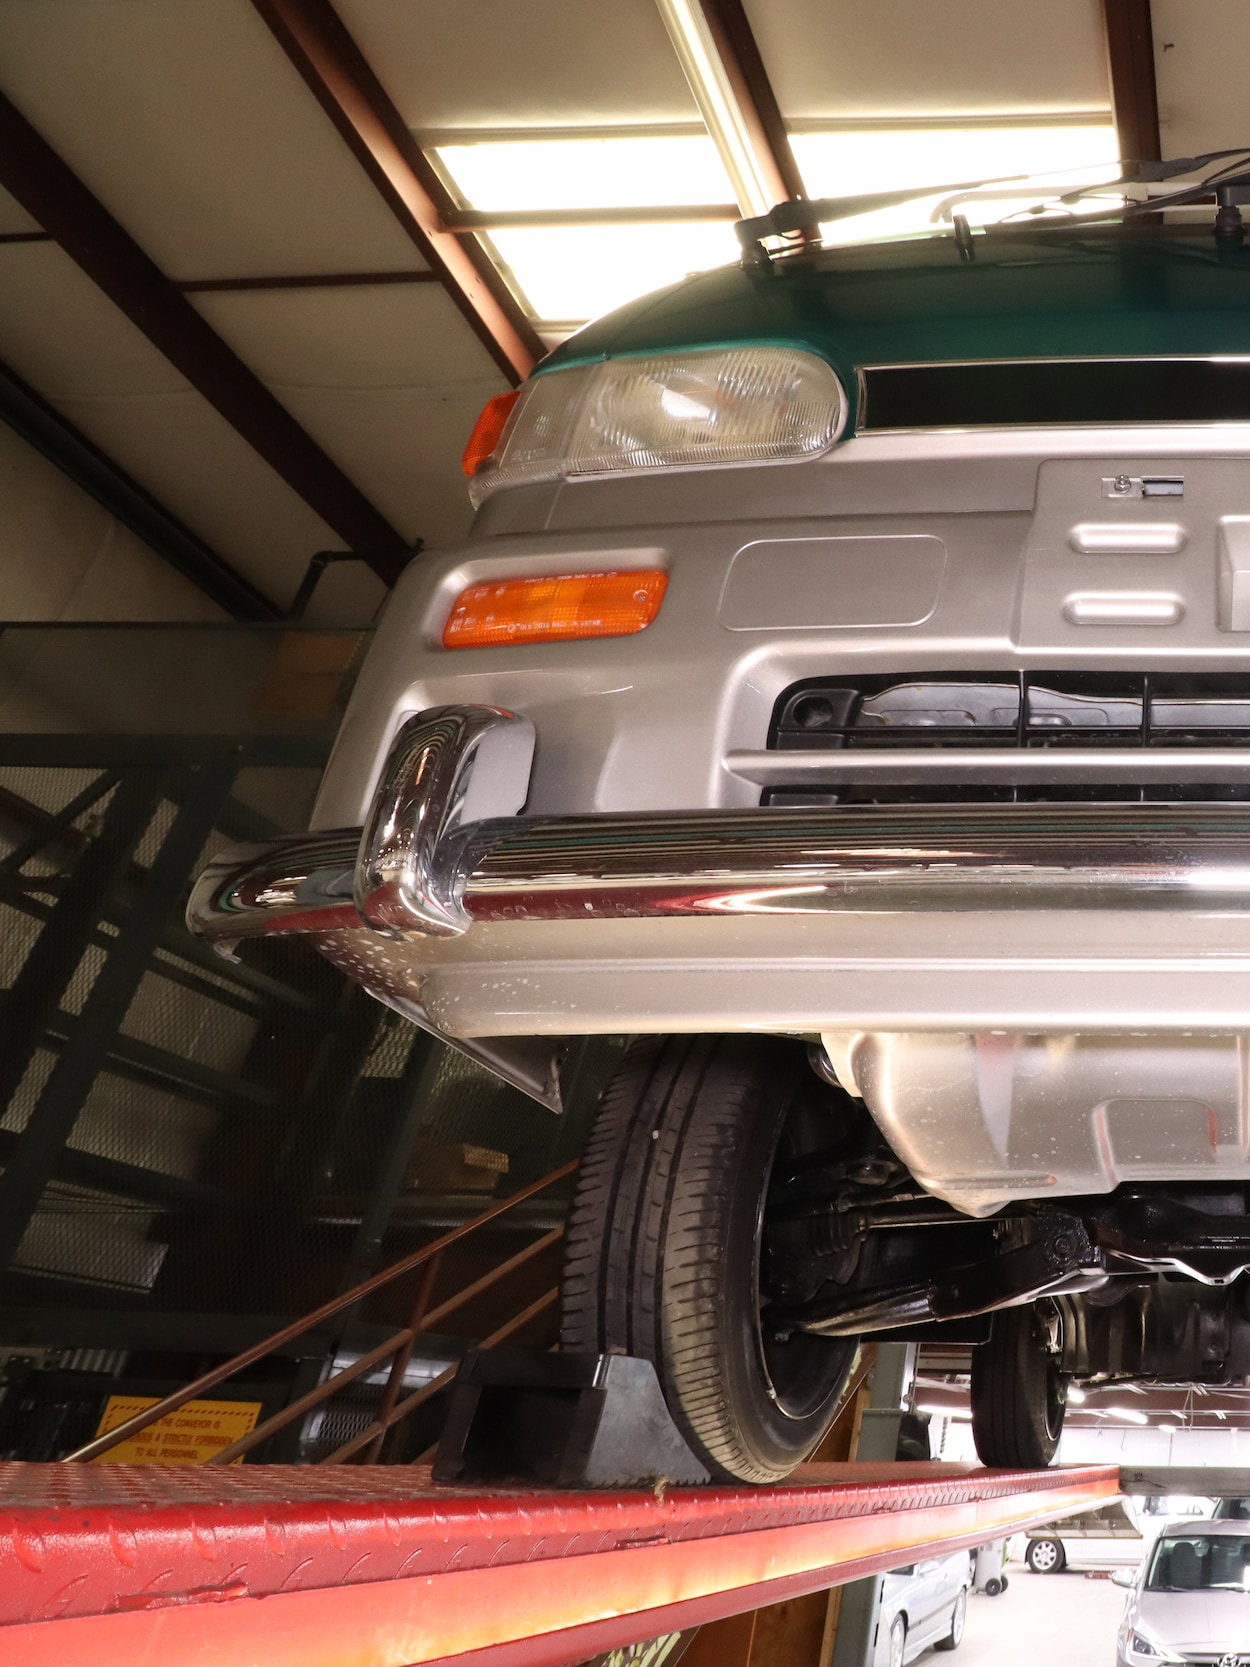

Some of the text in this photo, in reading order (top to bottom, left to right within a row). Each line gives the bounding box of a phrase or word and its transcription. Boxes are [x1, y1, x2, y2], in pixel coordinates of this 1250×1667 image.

[160, 1418, 173, 1427] THE
[175, 1419, 212, 1429] CONVEYOR
[145, 1448, 157, 1457] ALL
[160, 1449, 198, 1459] PERSONNEL
